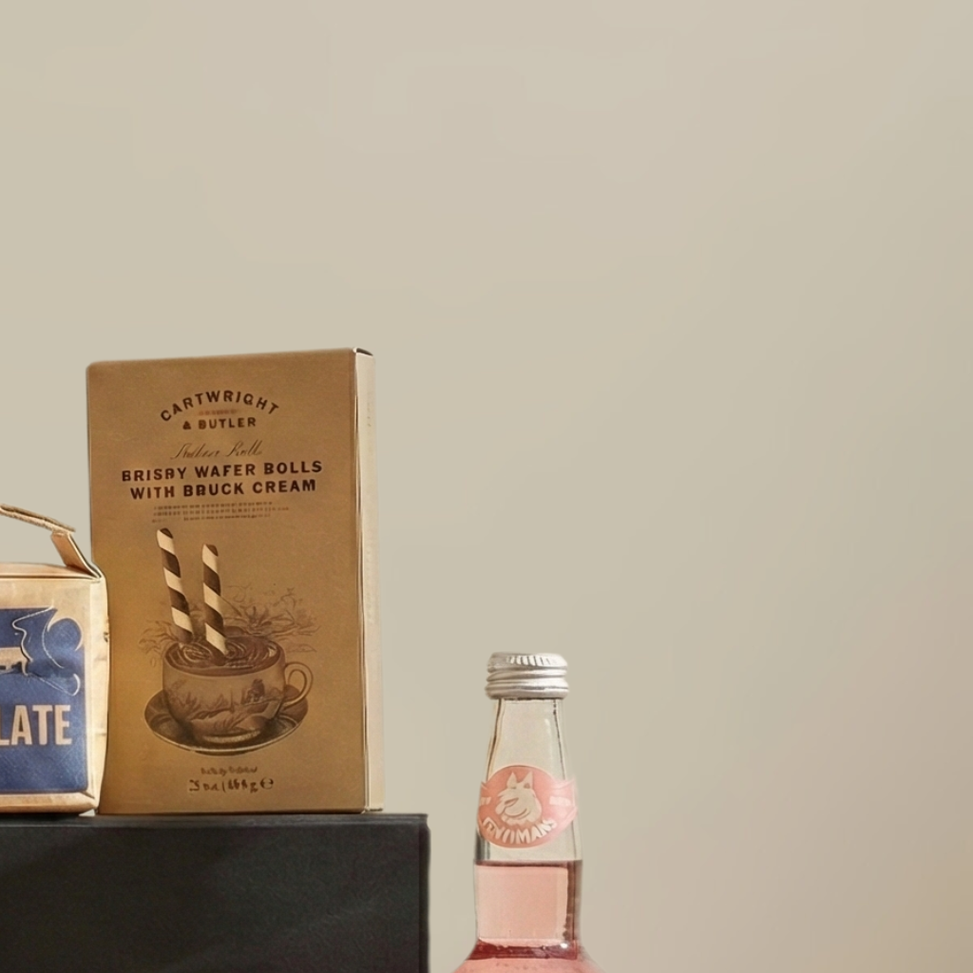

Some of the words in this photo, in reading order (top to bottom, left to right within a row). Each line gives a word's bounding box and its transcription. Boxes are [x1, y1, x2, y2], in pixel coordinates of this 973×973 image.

[160, 390, 279, 422] CARTWRIGHT
[198, 417, 257, 430] BUTLER
[194, 463, 256, 479] WAFER
[263, 460, 323, 476] BOLLS
[130, 486, 175, 500] WITH
[252, 479, 316, 494] CREAM
